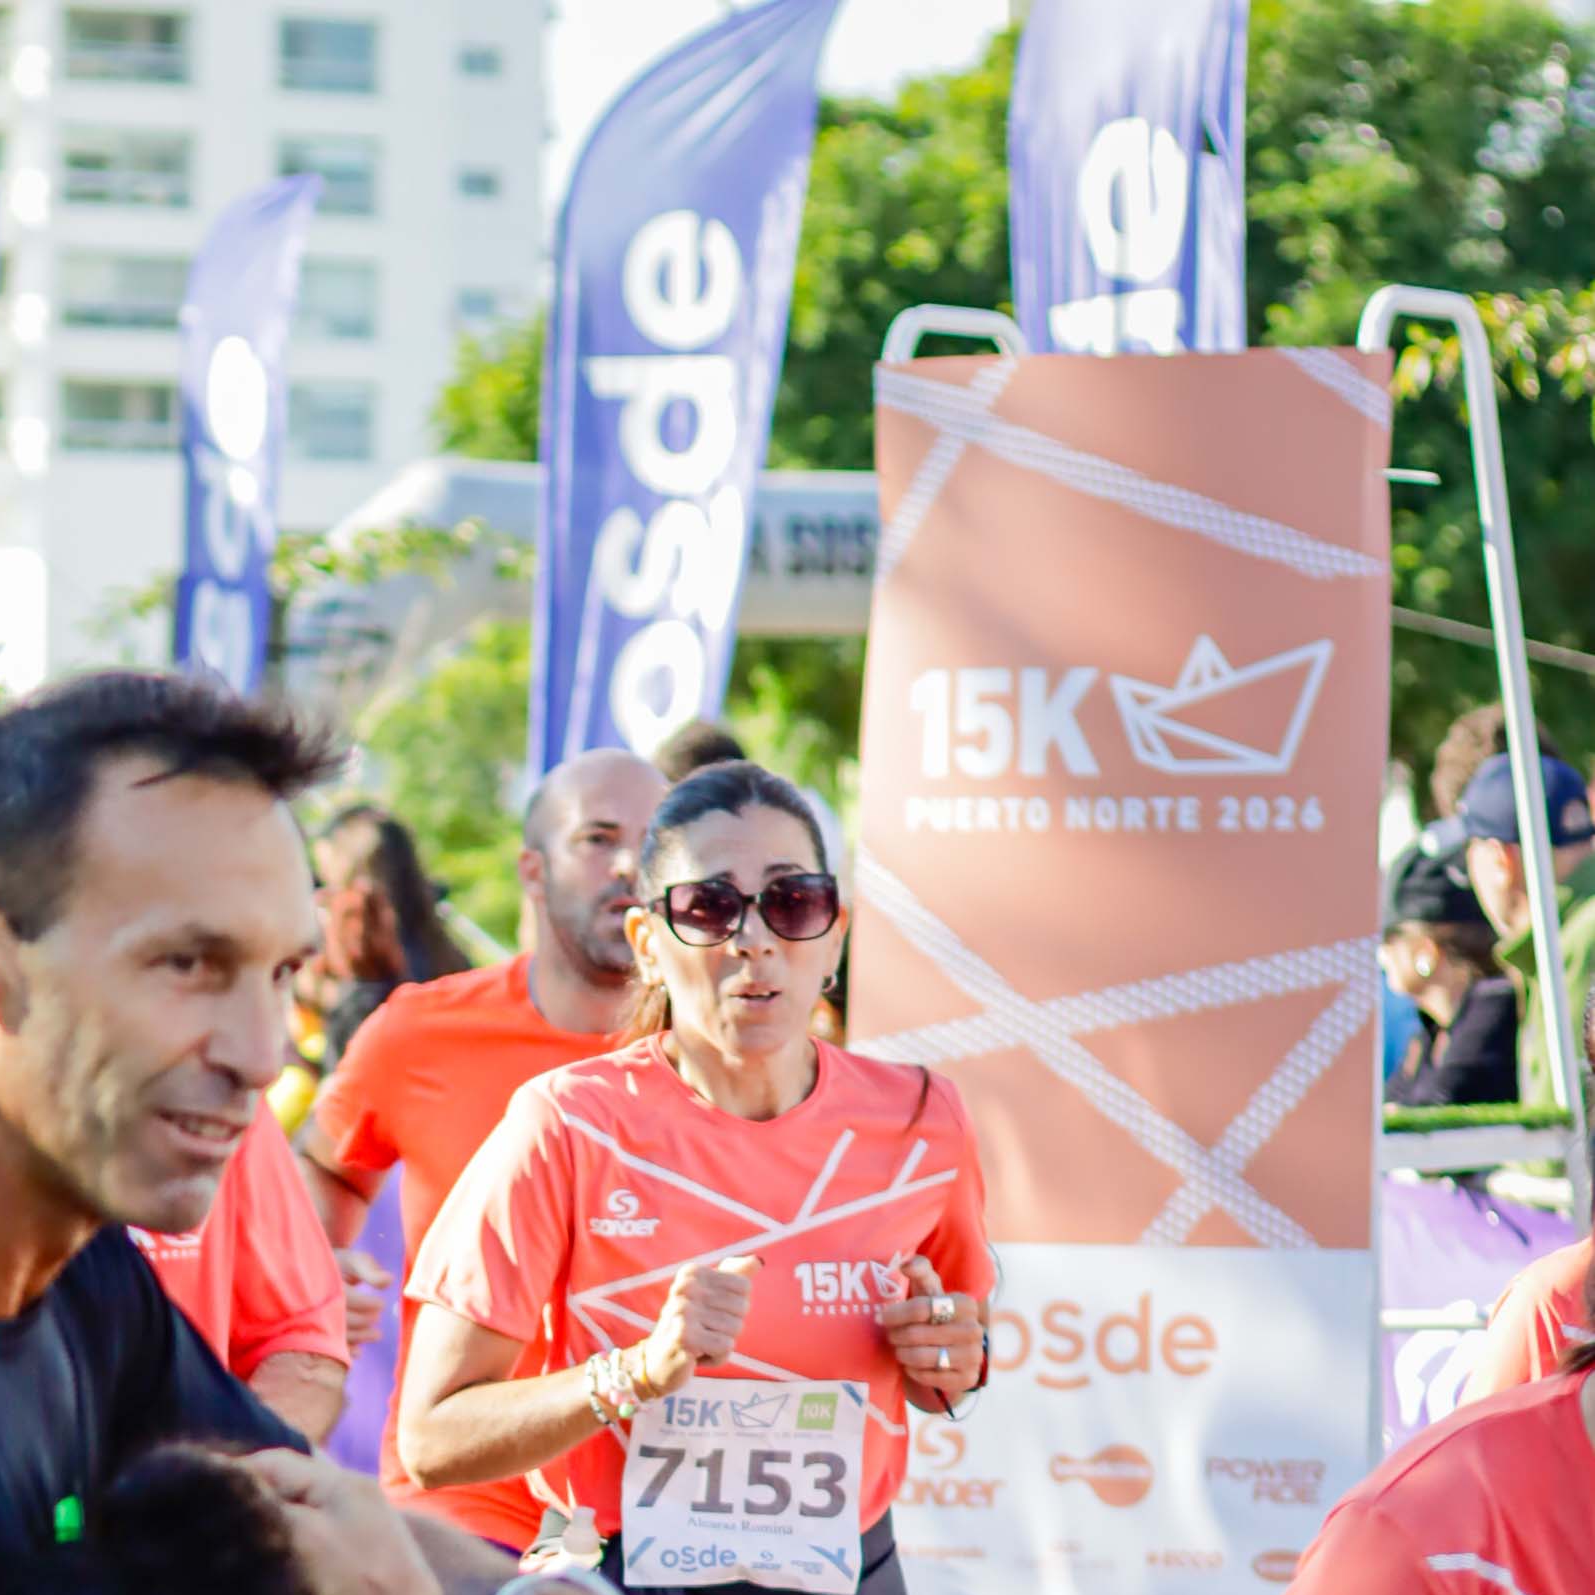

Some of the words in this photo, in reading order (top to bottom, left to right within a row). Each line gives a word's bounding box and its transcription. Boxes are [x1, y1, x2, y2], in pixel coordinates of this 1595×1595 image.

[583, 207, 745, 760] osde
[910, 666, 1100, 779] 15K
[906, 796, 1051, 832] PUERTO
[1065, 796, 1200, 832] NORTE
[1217, 796, 1325, 832] 2026
[794, 1261, 870, 1302] 15K
[662, 1396, 725, 1428] 15K
[636, 1445, 848, 1519] 7153
[660, 1544, 737, 1573] osde
